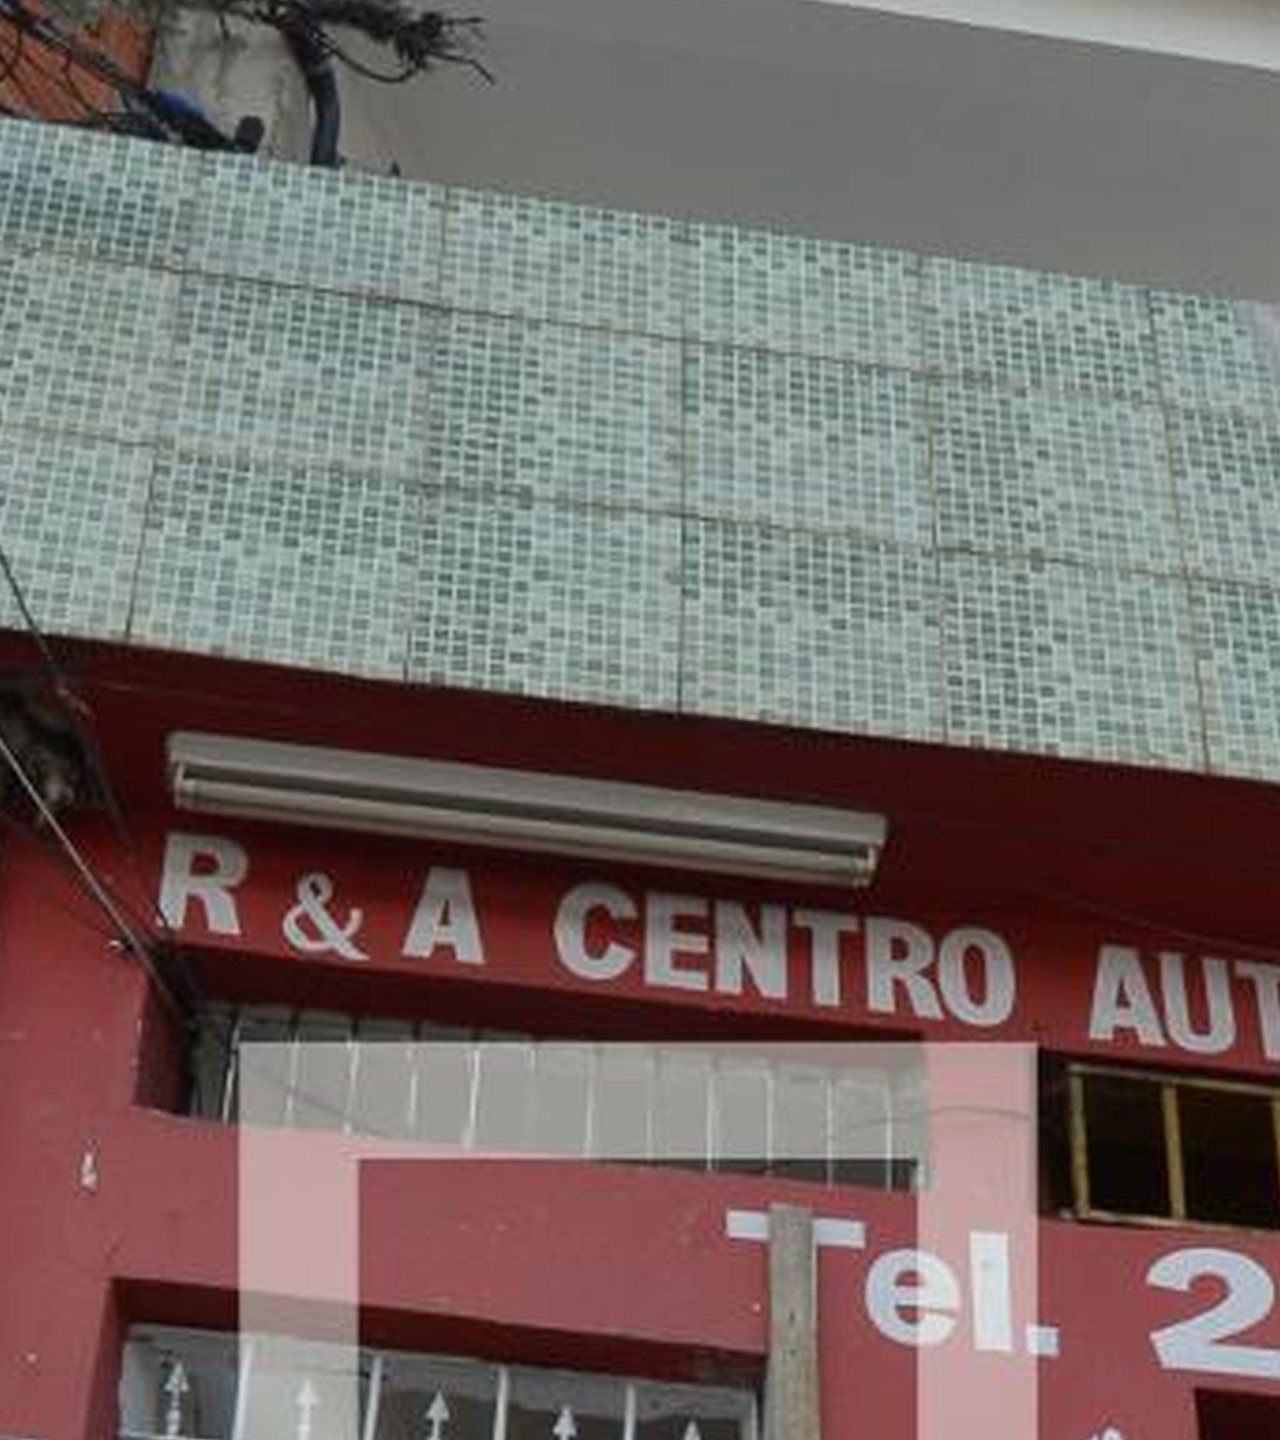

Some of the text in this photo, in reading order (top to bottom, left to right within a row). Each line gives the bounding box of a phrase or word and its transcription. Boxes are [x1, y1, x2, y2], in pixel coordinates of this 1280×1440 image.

[158, 833, 250, 935] R
[281, 872, 369, 961] &
[402, 867, 486, 964] A
[551, 882, 1016, 1027] CENTRO
